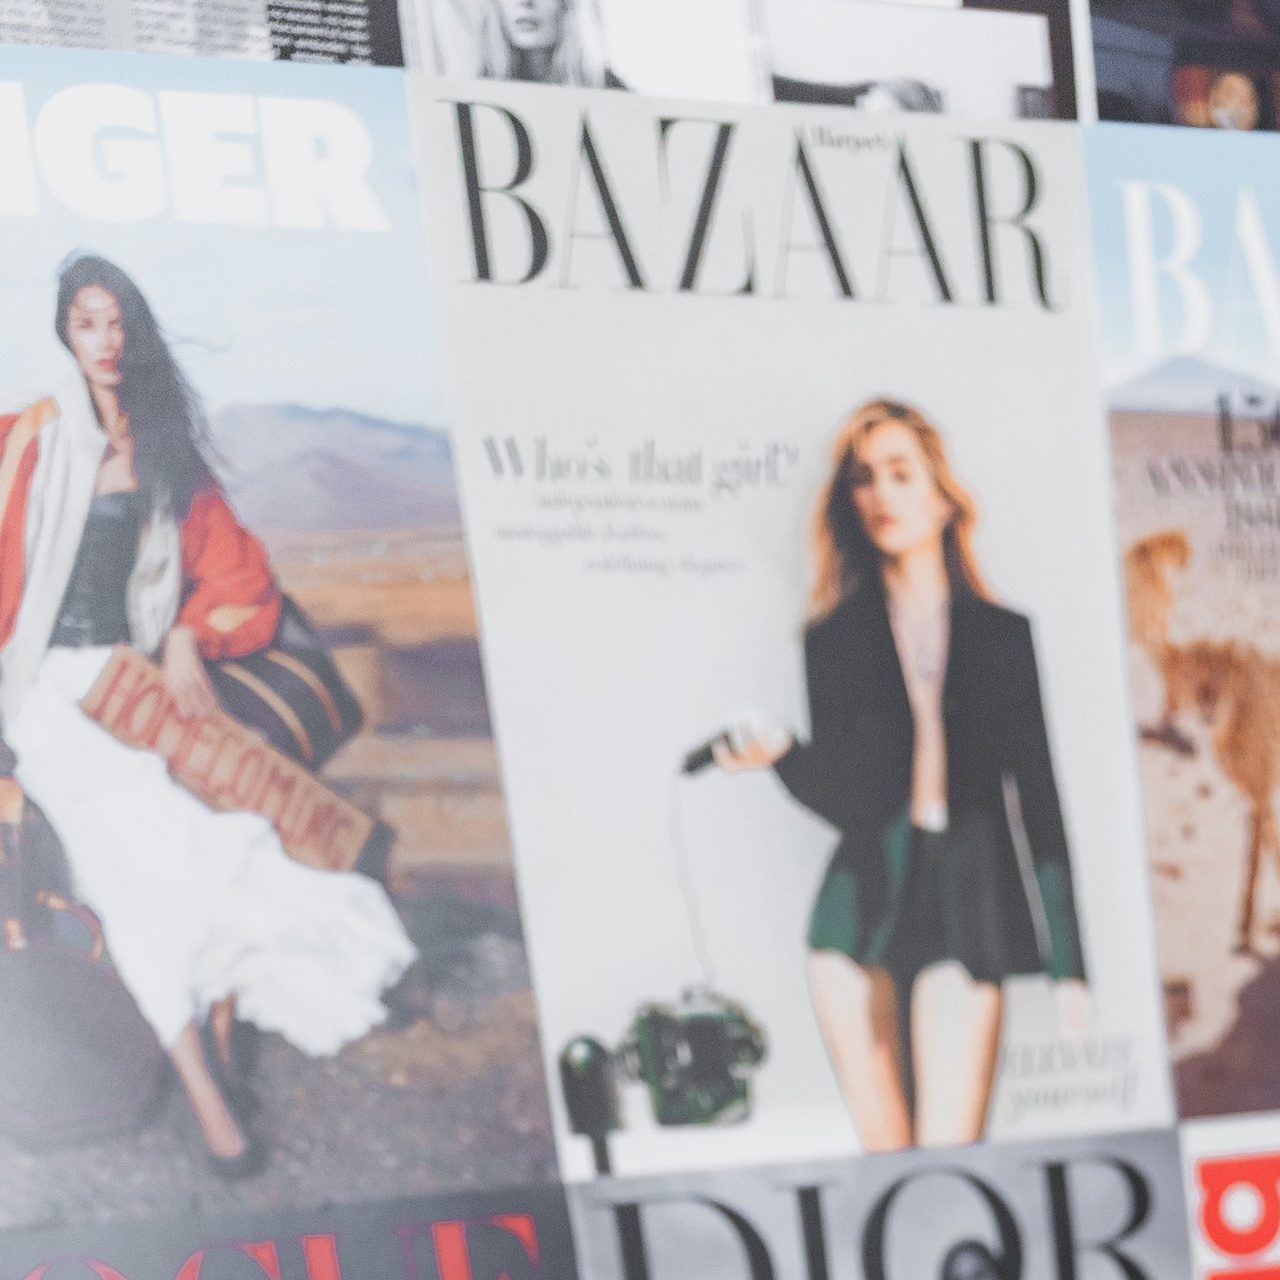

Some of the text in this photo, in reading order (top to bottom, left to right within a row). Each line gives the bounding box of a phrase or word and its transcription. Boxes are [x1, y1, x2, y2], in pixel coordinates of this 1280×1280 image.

[440, 99, 1069, 313] BAZAAR
[482, 434, 611, 488] Who's
[628, 436, 705, 488] that
